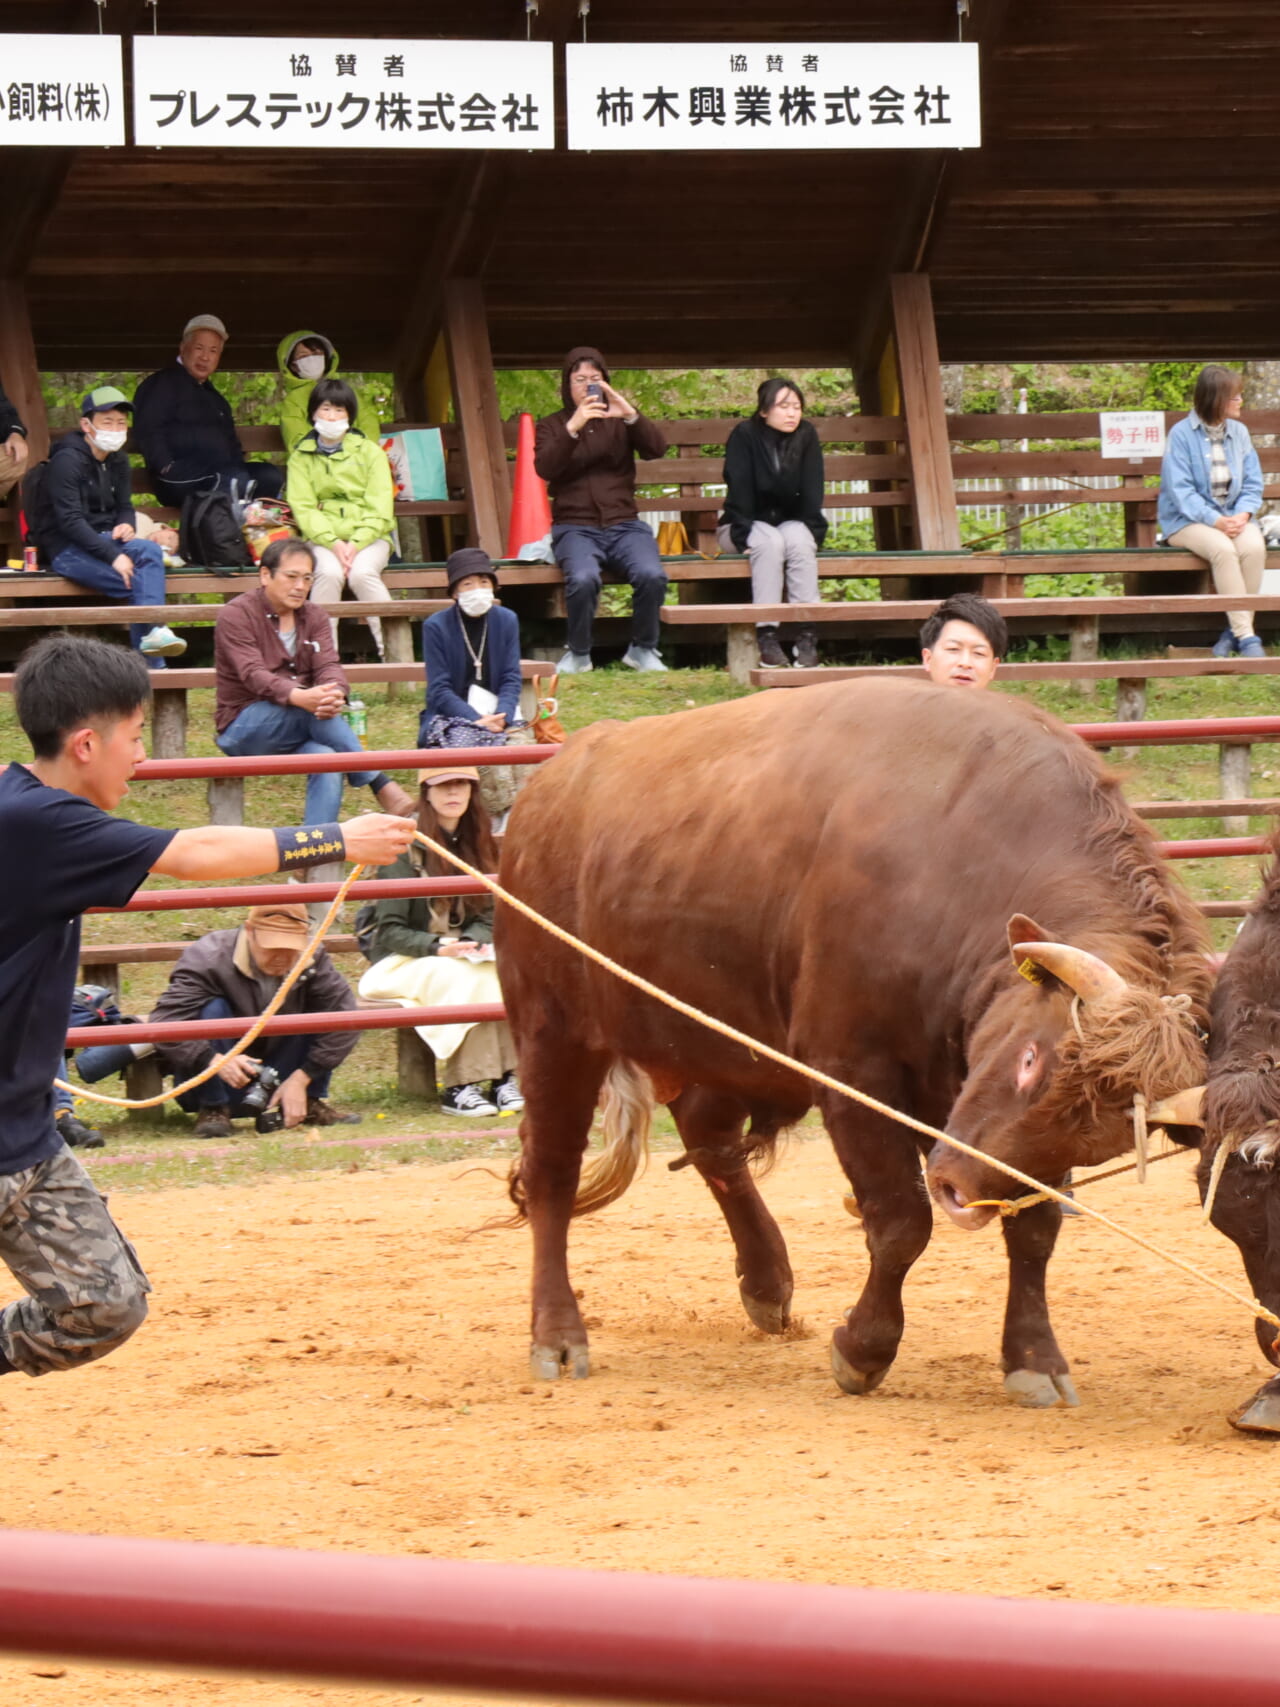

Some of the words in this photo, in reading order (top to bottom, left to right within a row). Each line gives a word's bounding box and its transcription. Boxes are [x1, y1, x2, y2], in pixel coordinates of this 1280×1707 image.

[289, 54, 405, 77] 協賛者
[730, 54, 820, 73] 協賛者
[0, 82, 109, 121] 飼料(株)
[149, 91, 539, 133] プレステック株式会社
[597, 85, 952, 127] 柿木興業株式会社
[1107, 427, 1160, 444] 勢子用
